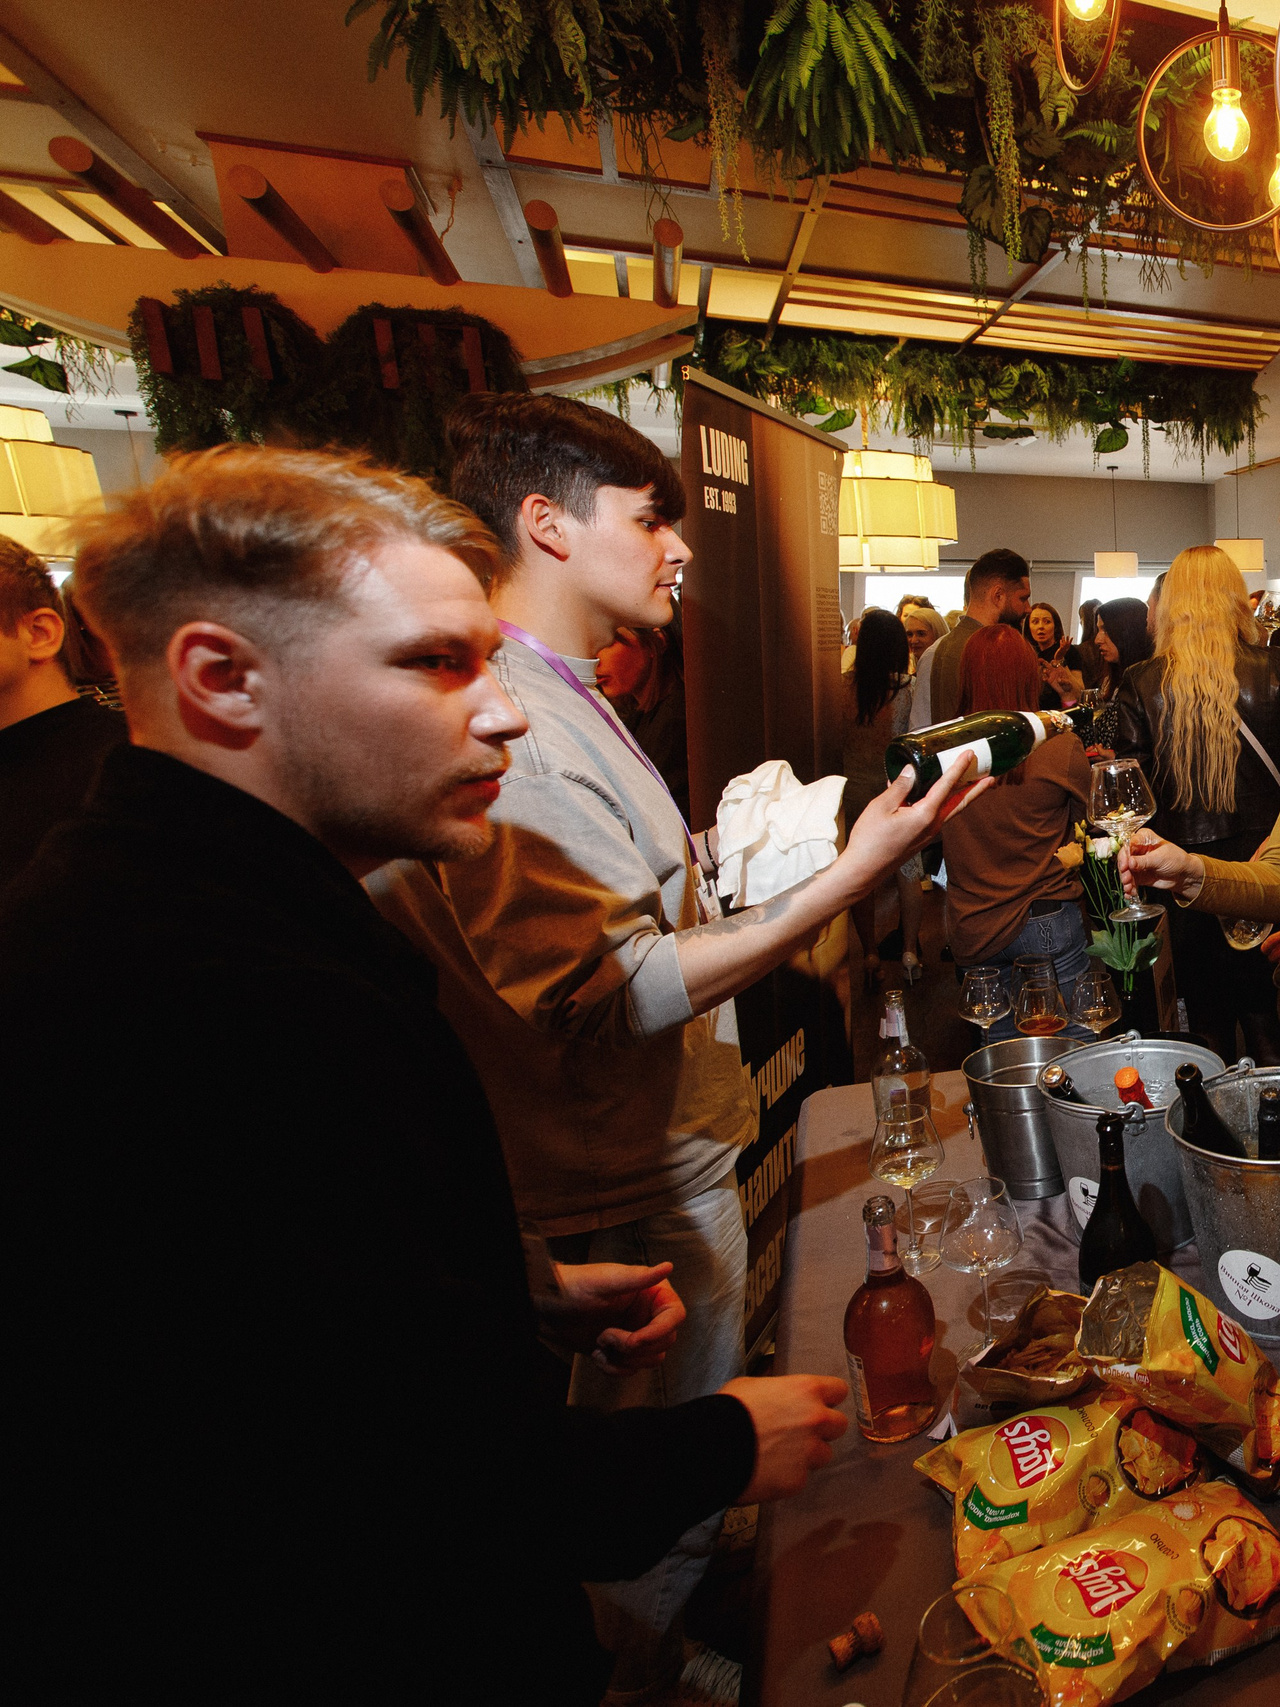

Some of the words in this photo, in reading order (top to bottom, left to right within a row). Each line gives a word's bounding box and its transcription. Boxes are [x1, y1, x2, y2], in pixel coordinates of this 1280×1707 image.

[699, 425, 749, 486] LUDING
[703, 486, 722, 511] EST.
[738, 1122, 798, 1232] напит
[745, 1222, 787, 1325] всег
[1250, 1291, 1280, 1315] Школа
[1000, 1421, 1056, 1485] Lay's
[1066, 1559, 1136, 1614] Lay's
